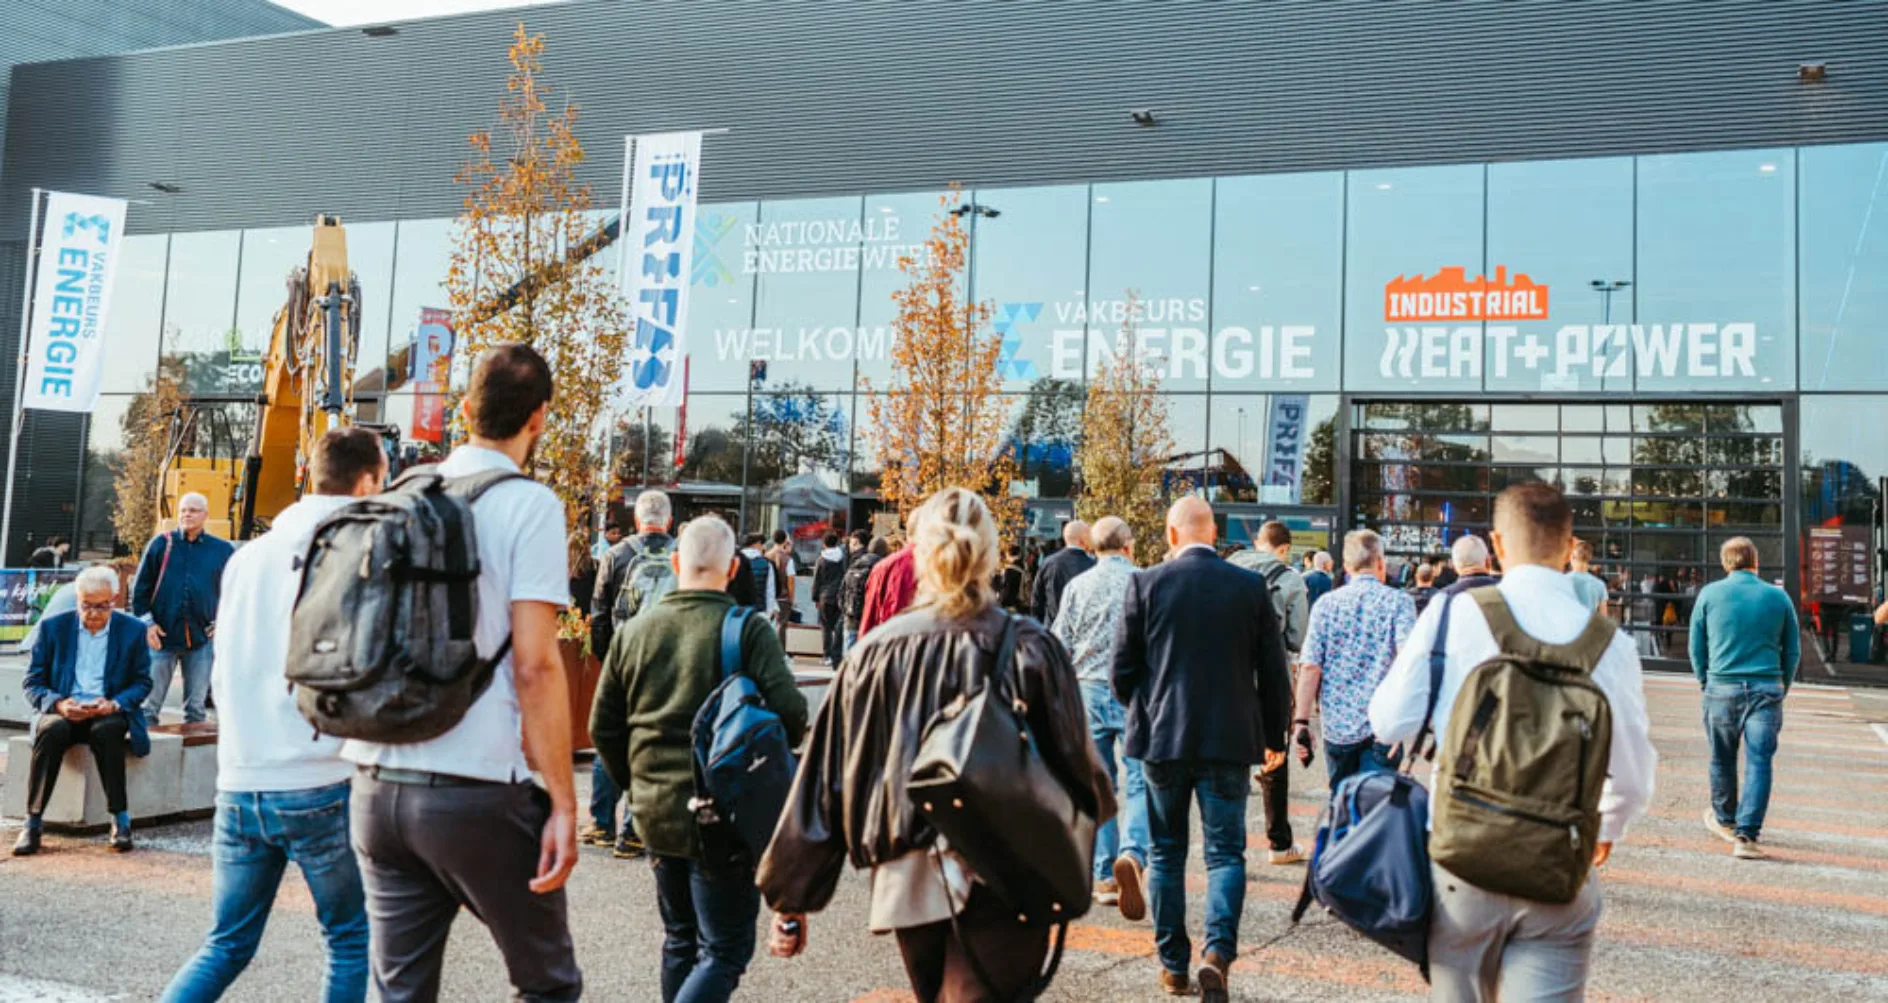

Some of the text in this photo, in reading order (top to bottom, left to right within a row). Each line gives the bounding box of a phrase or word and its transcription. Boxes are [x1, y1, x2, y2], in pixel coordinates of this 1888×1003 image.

[743, 216, 900, 248] NATIONALE
[81, 251, 106, 340] VAKBEURS
[1054, 299, 1206, 323] VAKBEURS
[1389, 289, 1543, 318] INDUSTRIAL
[41, 247, 89, 397] ENERGIE
[1051, 325, 1316, 380] ENERGIE
